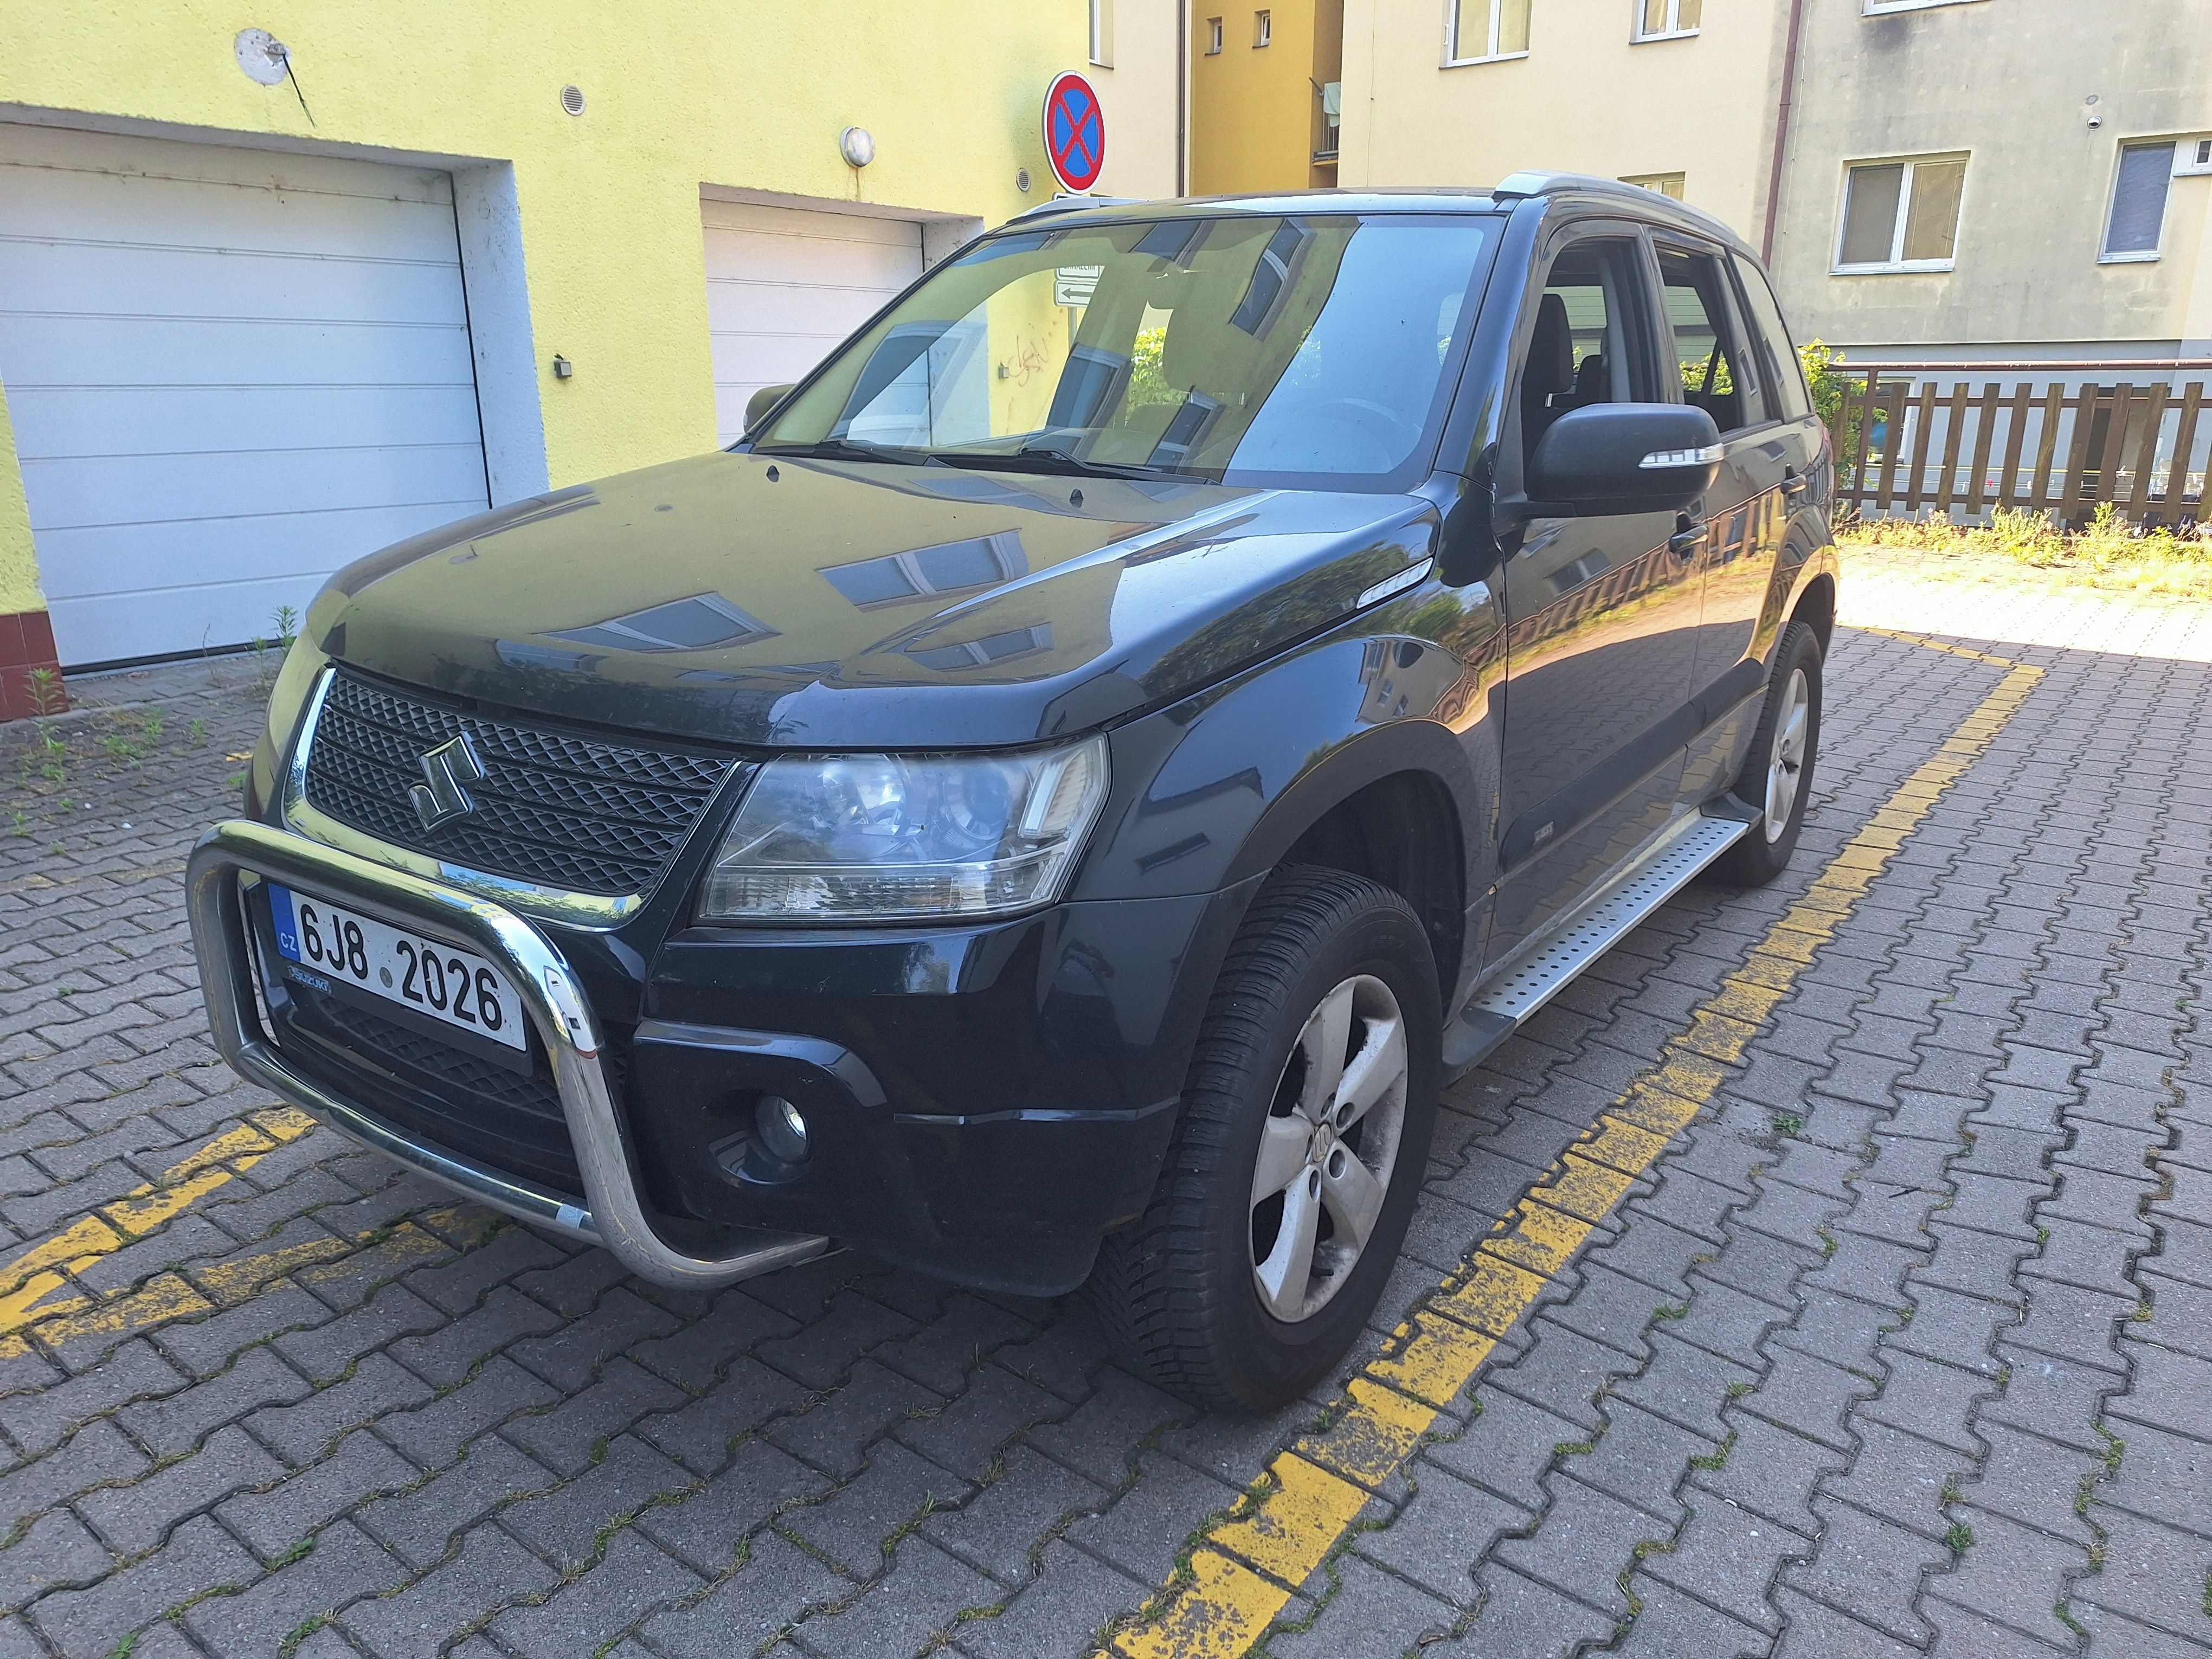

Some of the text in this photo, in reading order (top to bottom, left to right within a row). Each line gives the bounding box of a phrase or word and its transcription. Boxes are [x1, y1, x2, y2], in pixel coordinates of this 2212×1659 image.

[280, 932, 298, 952] CZ
[300, 904, 502, 1031] 6J8 2026
